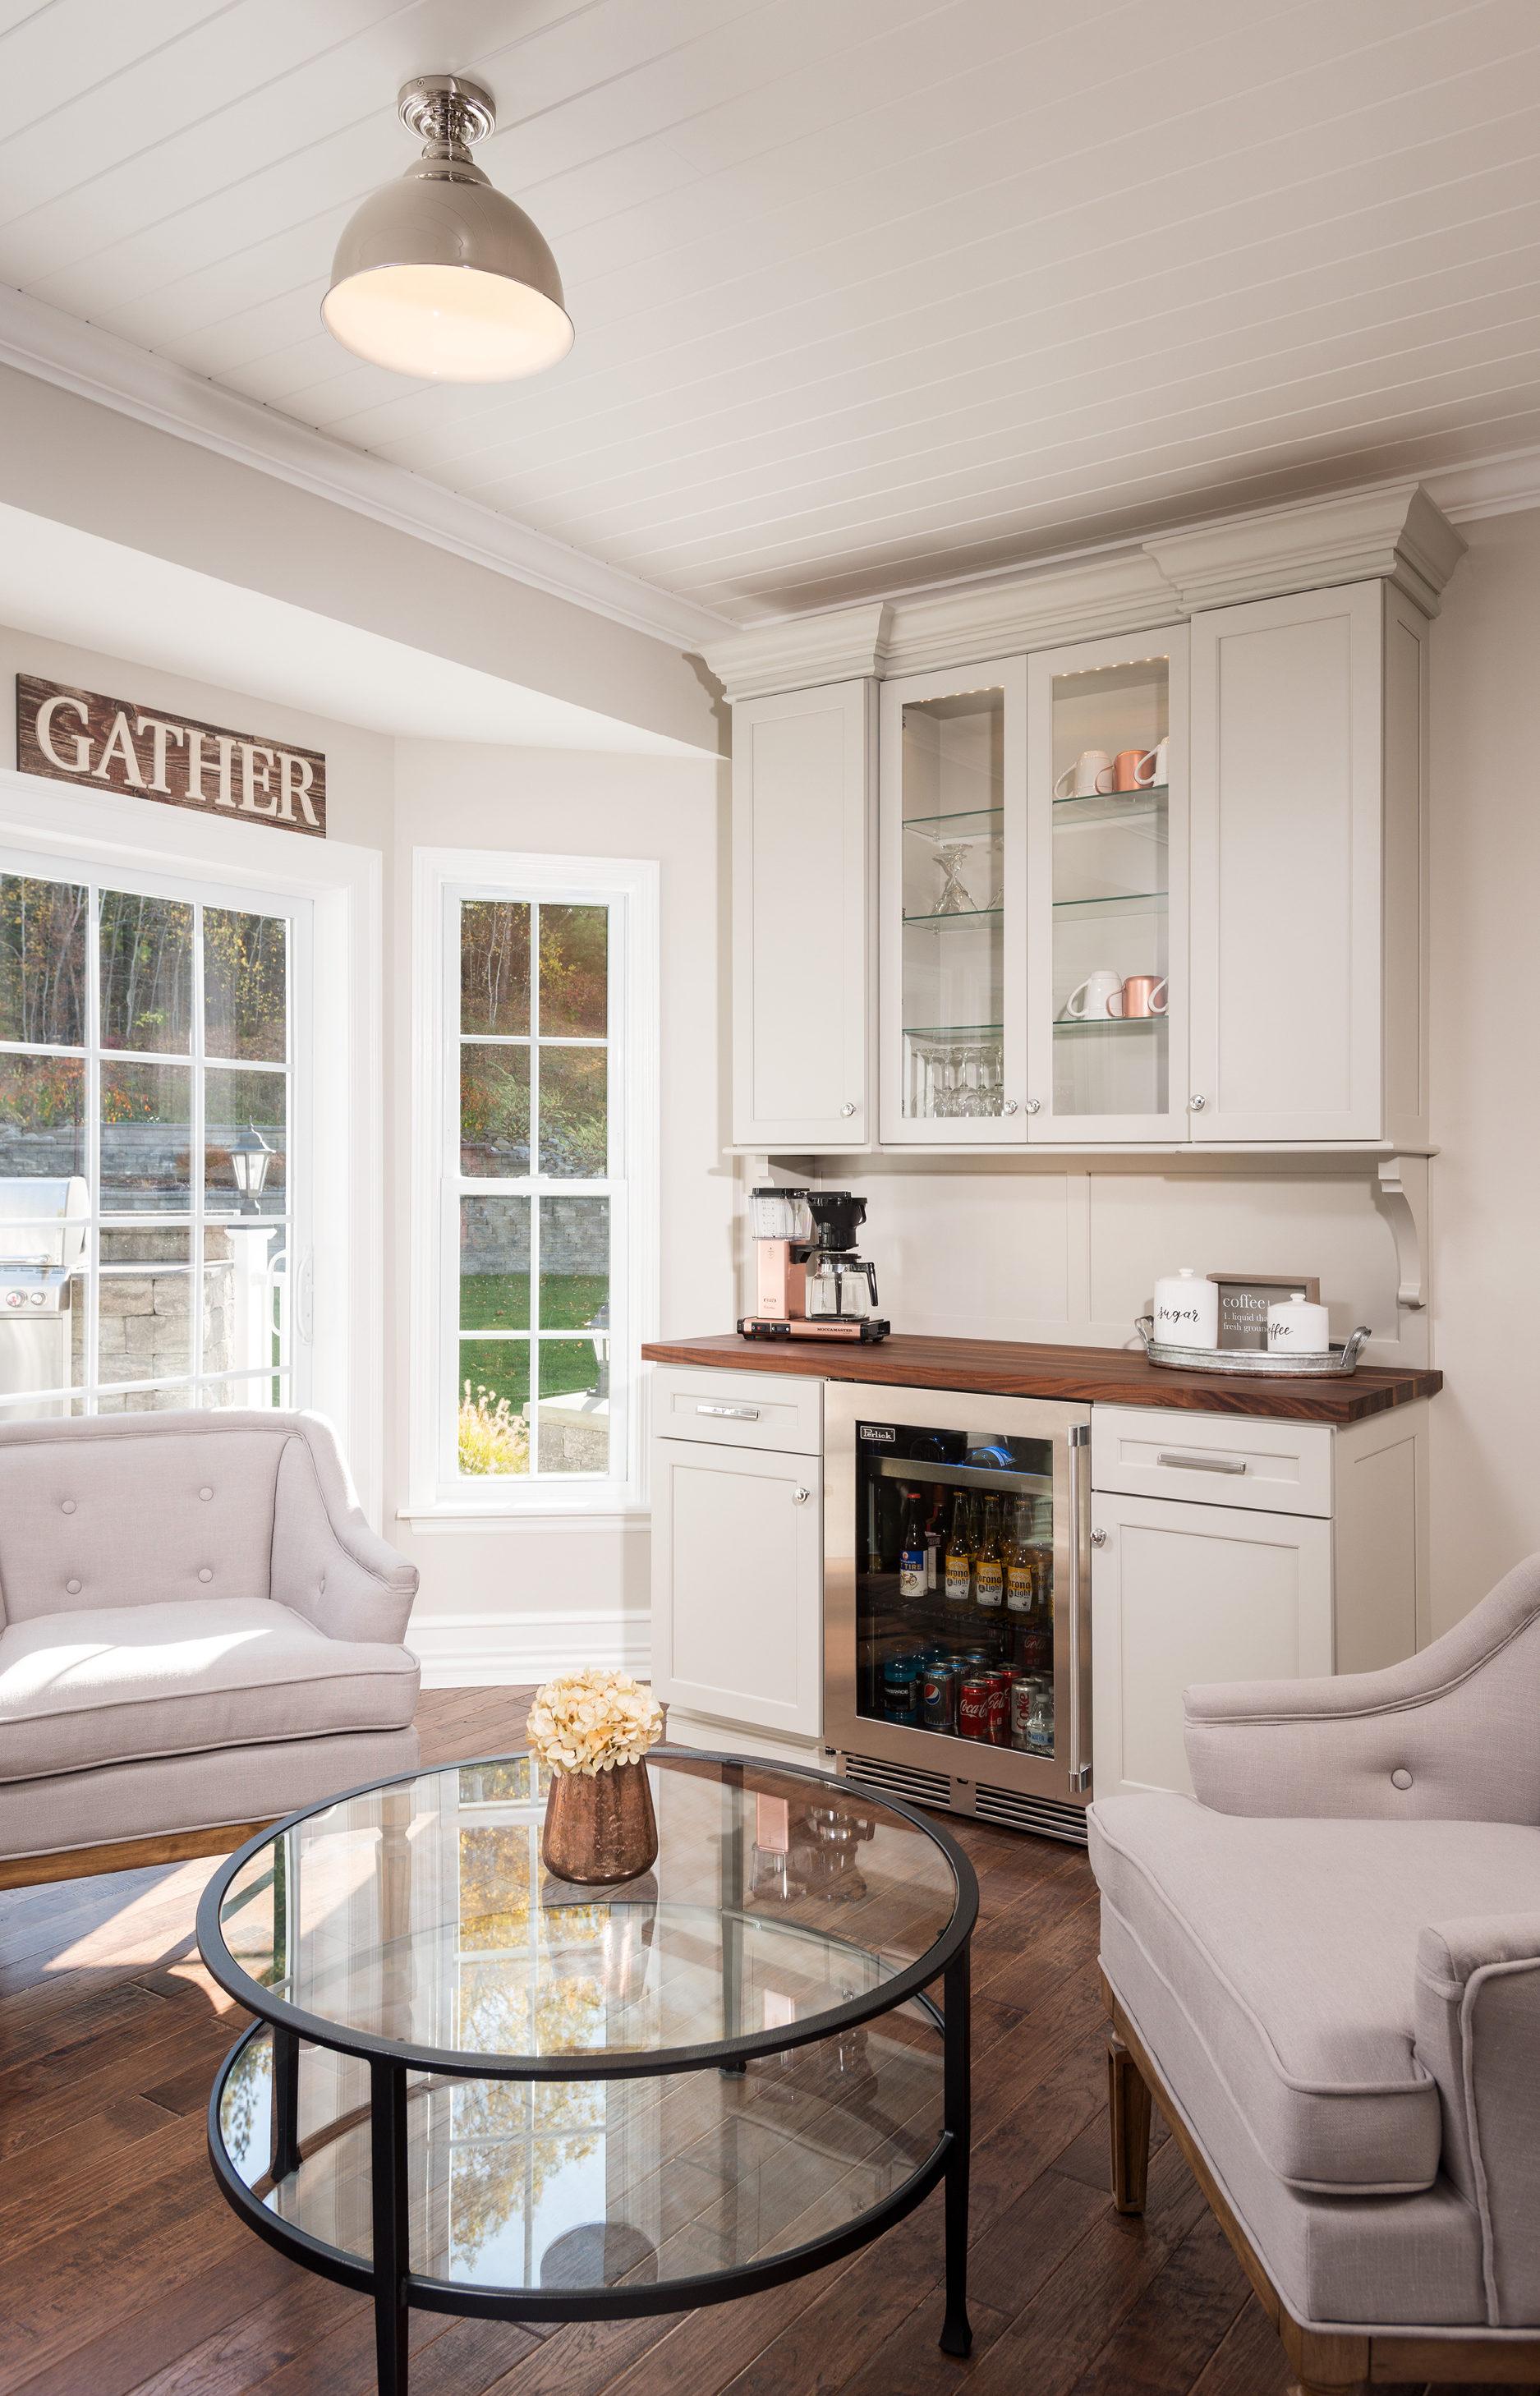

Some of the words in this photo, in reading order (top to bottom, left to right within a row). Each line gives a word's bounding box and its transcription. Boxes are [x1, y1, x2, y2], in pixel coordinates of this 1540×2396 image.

[35, 696, 320, 826] GATHER
[1223, 1294, 1266, 1309] coffee
[1157, 1306, 1200, 1323] sugar
[1232, 1313, 1254, 1322] liquid
[1223, 1322, 1241, 1331] fresh
[863, 1428, 892, 1439] Perlick
